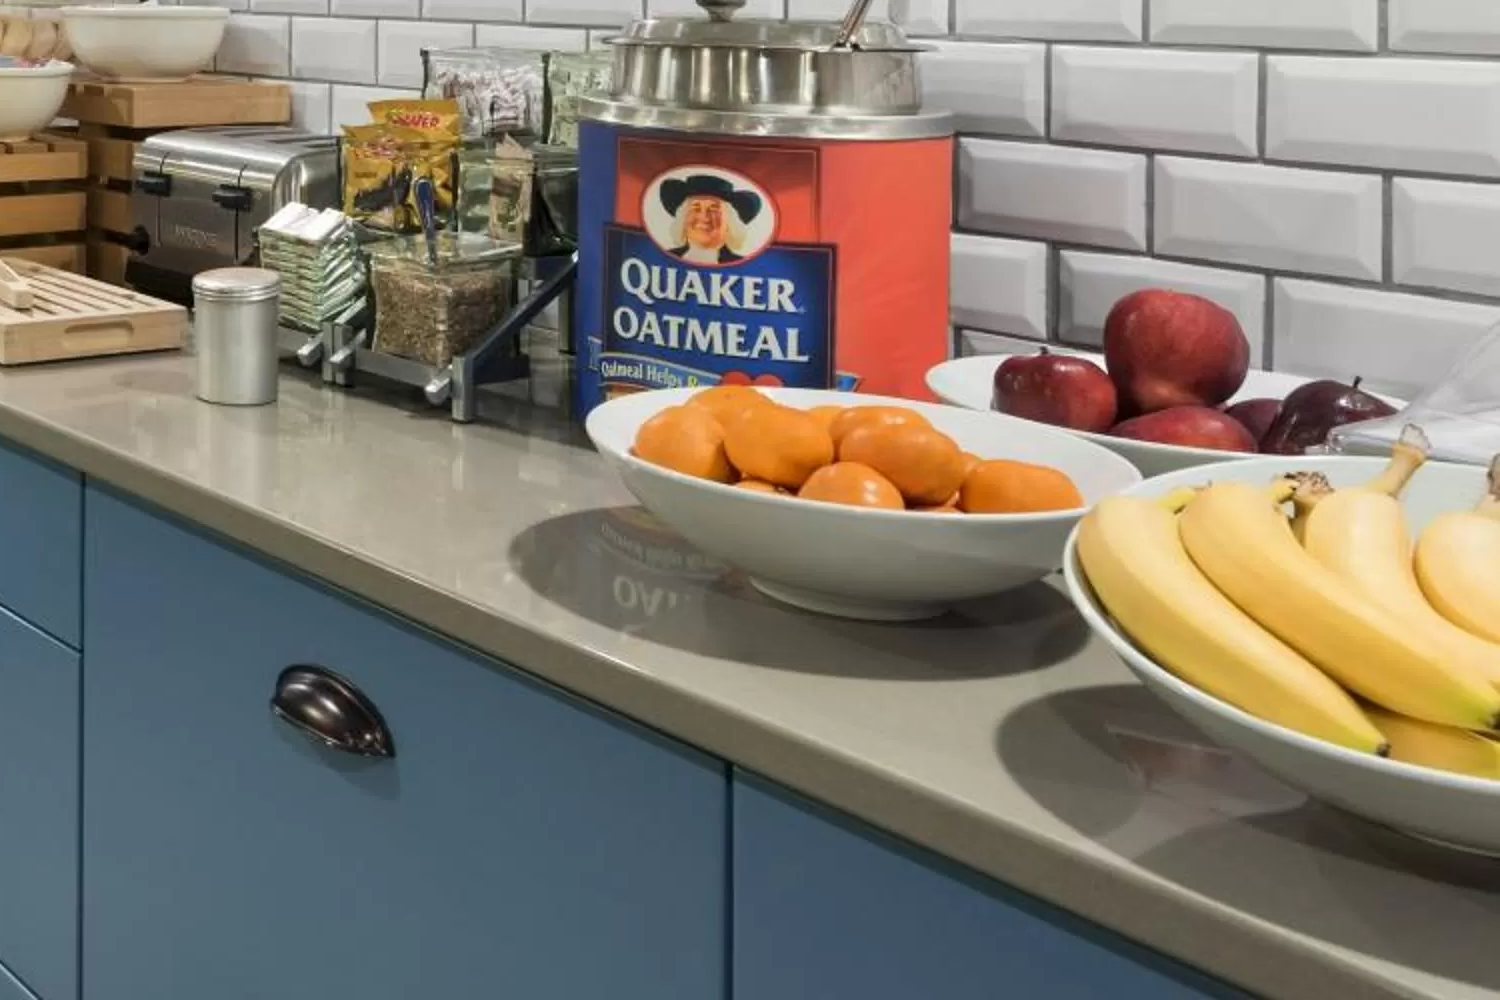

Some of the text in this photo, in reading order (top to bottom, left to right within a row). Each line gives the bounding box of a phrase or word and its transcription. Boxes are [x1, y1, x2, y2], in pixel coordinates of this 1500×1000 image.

[620, 257, 798, 313] QUAKER
[613, 306, 809, 363] OATMEAL
[601, 360, 643, 379] Oatmeal
